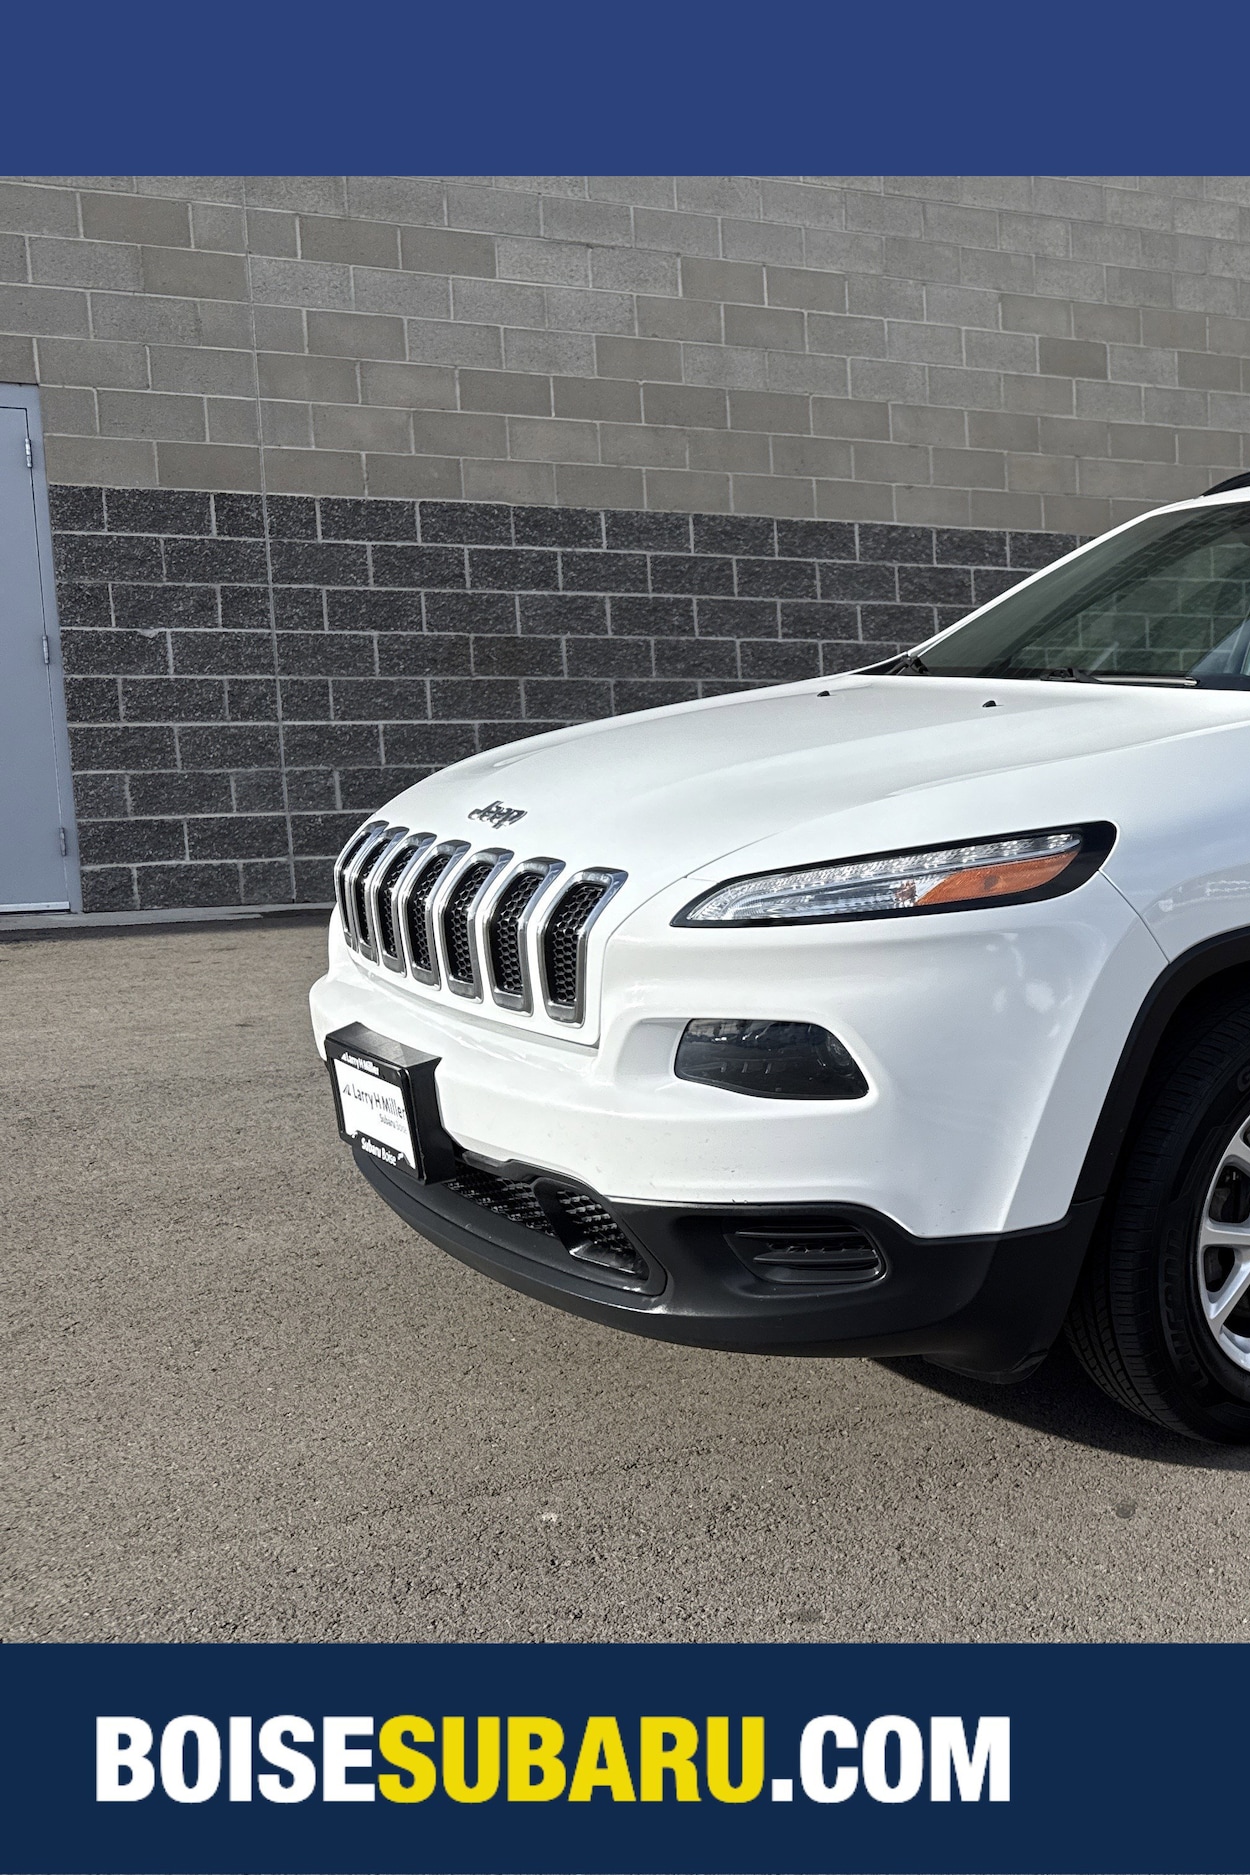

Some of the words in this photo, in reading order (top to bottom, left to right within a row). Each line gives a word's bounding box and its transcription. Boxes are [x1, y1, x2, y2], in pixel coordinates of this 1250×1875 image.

[468, 800, 528, 829] Jeep
[352, 1083, 374, 1110] Larry
[374, 1092, 382, 1109] H
[381, 1095, 406, 1120] Miller
[361, 1137, 382, 1159] Subaru
[381, 1147, 397, 1166] Boise
